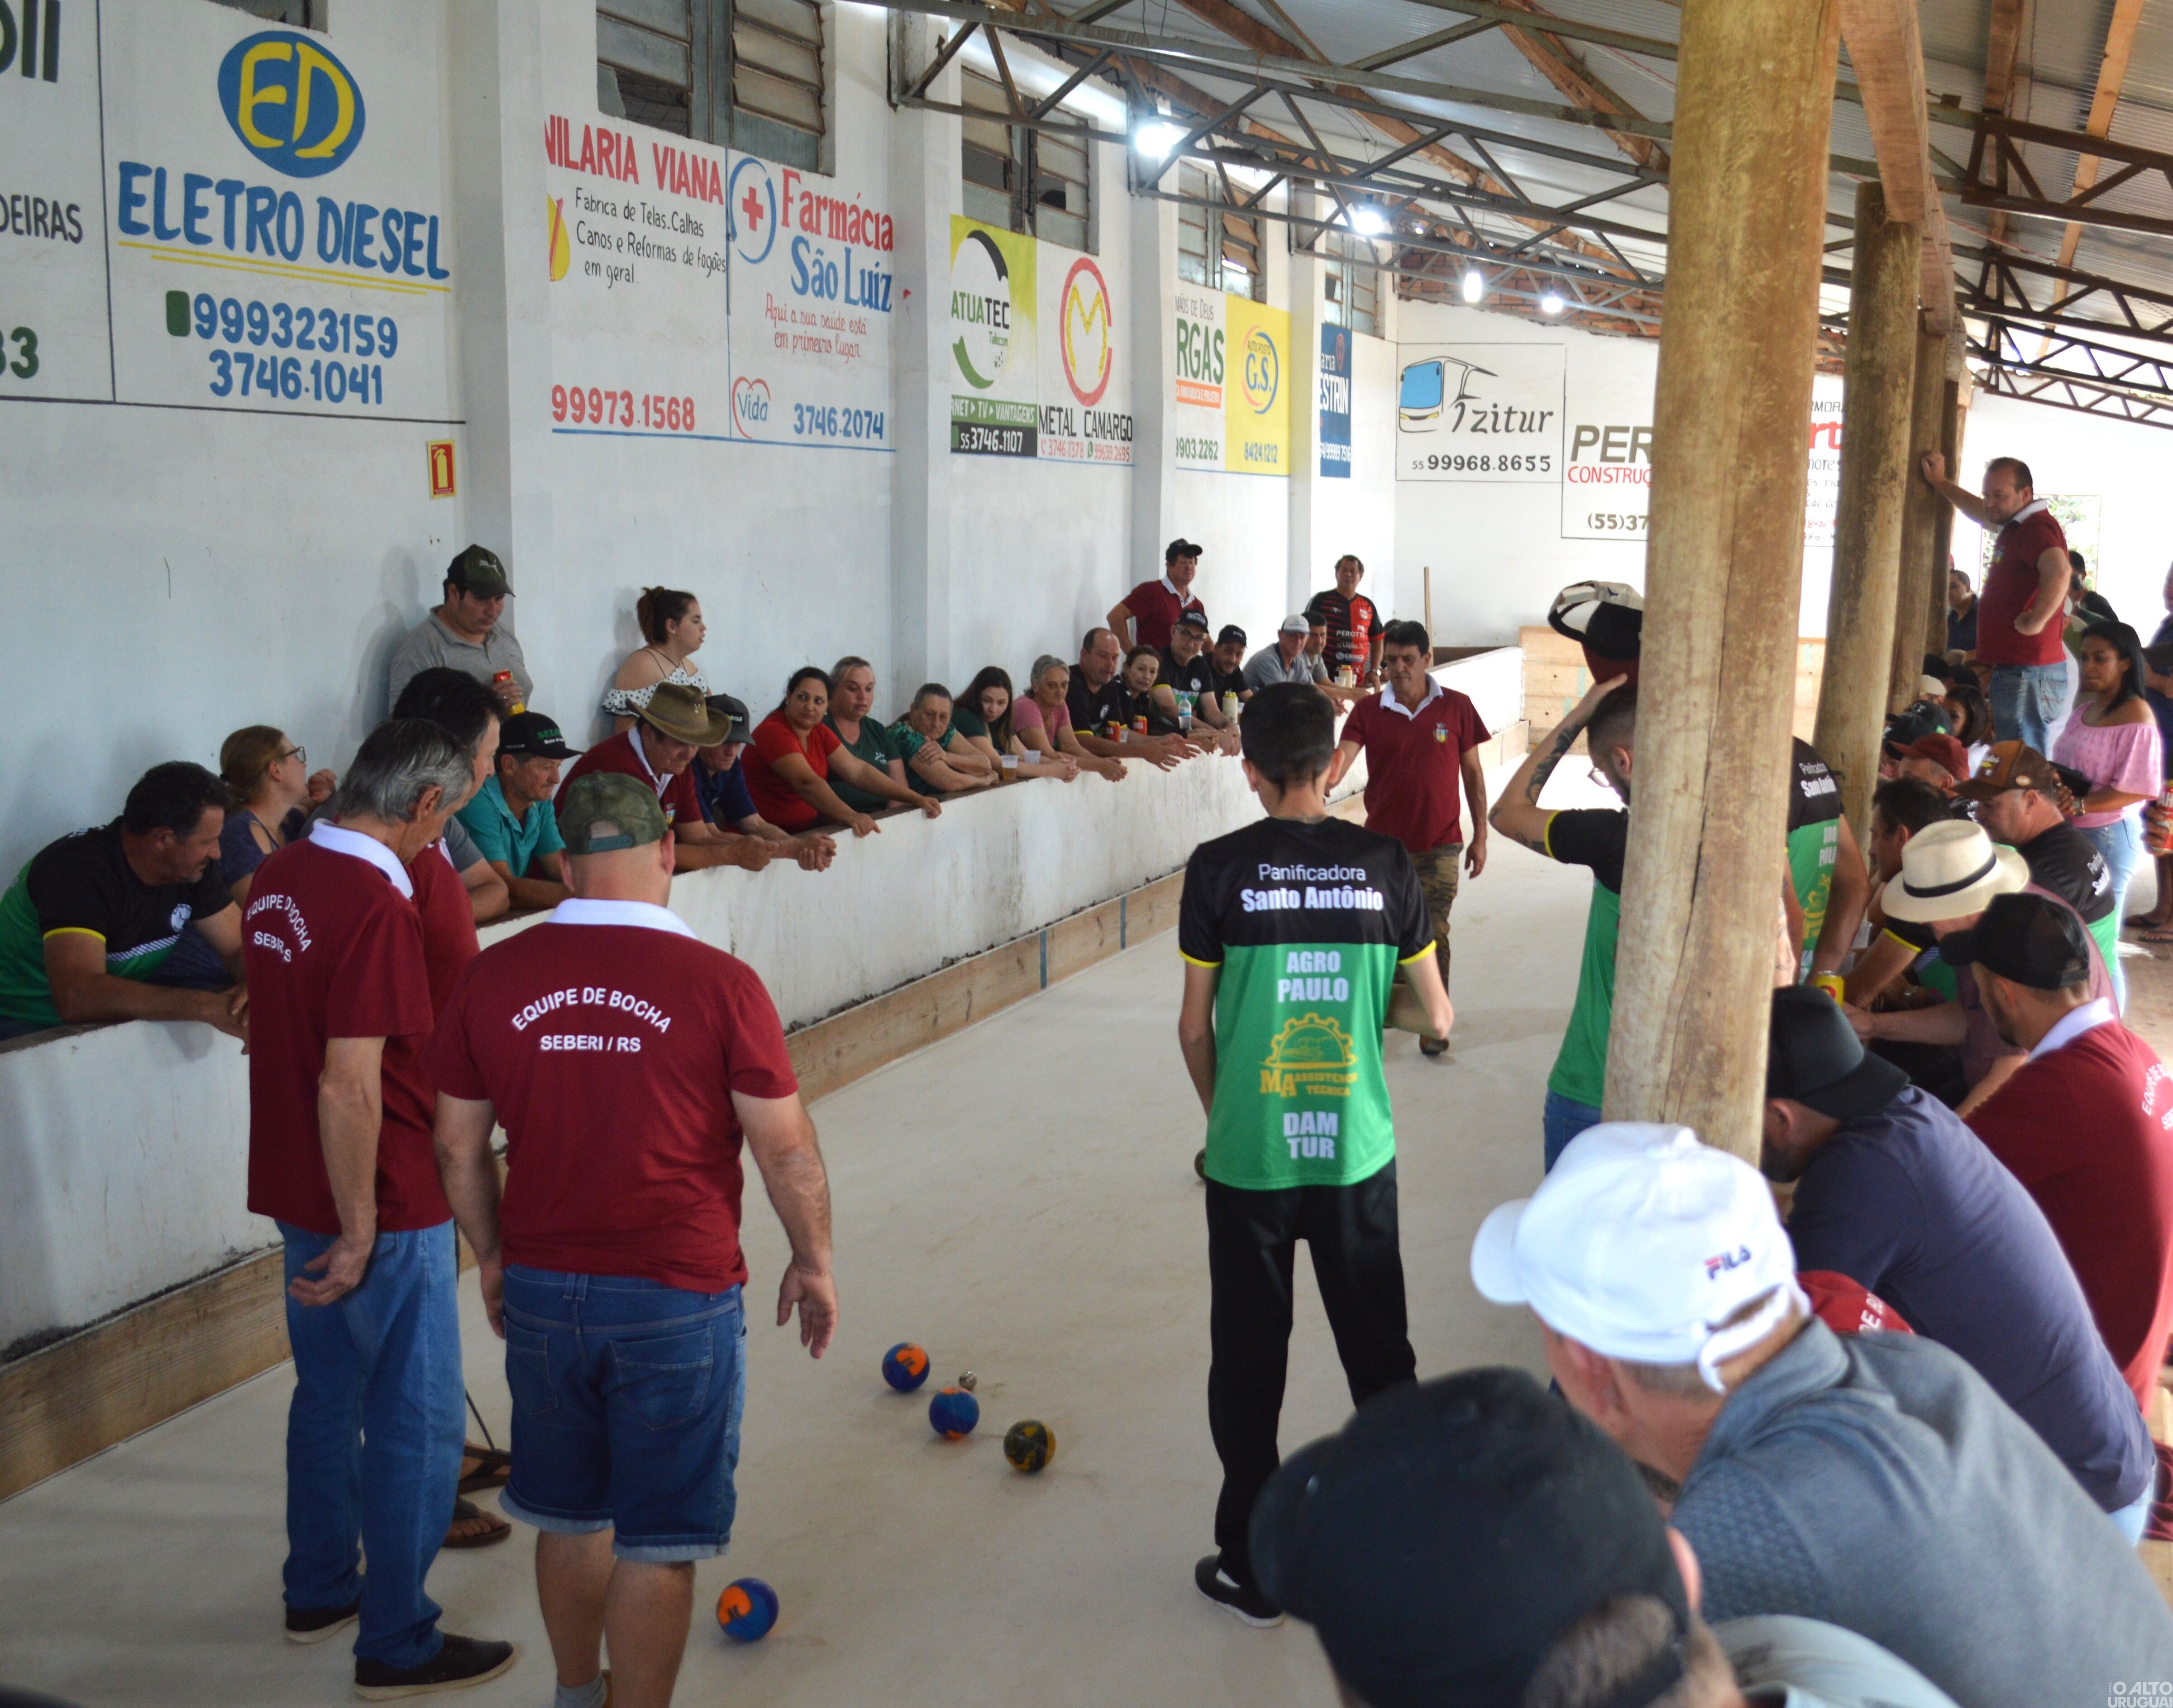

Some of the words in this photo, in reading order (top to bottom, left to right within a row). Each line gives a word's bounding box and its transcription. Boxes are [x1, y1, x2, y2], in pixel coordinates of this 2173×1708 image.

[652, 143, 724, 205] VIANA
[118, 161, 304, 261] ELETRO
[316, 196, 450, 280] DIESEL
[623, 200, 635, 221] de
[781, 167, 893, 252] Farmácia
[576, 220, 612, 250] Canos
[616, 237, 623, 253] e
[627, 231, 676, 262] Reformas
[683, 246, 694, 266] de
[584, 260, 601, 277] em
[791, 235, 838, 301] São
[844, 247, 892, 313] Luiz
[193, 292, 398, 358] 999323159
[765, 292, 788, 328] Aqui
[791, 309, 798, 324] a
[800, 310, 817, 326] sua
[951, 290, 1010, 329] ATUATEC
[0, 326, 39, 379] 3
[774, 331, 788, 348] em
[793, 330, 832, 356] primeiro
[835, 333, 861, 363] lugar
[209, 349, 382, 404] 3746.1041
[551, 384, 695, 431] 99973.1568
[736, 392, 769, 421] Vida
[793, 403, 884, 440] 3746.2074
[978, 401, 989, 418] TV
[996, 402, 1035, 423] VANTAGENS
[1038, 405, 1077, 437] METAL
[1084, 410, 1132, 442] CAMARGO
[1811, 401, 1842, 413] MOR
[1412, 459, 1424, 470] 55
[1427, 454, 1551, 472] 99968.8655
[1336, 630, 1364, 638] PEROTTI
[1258, 863, 1366, 882] Panificadora
[1241, 887, 1301, 912] Santo
[1304, 885, 1384, 911] Antônio
[1286, 951, 1341, 973] AGRO
[1277, 978, 1348, 1002] PAULO
[511, 988, 578, 1031] EQUIPE
[583, 987, 607, 1004] DE
[609, 990, 671, 1033] BOCHA
[540, 1035, 603, 1050] SEBERI
[617, 1036, 641, 1052] RS
[1283, 1111, 1338, 1136] DAM
[1287, 1136, 1335, 1159] TUR
[1704, 1244, 1751, 1279] FILA
